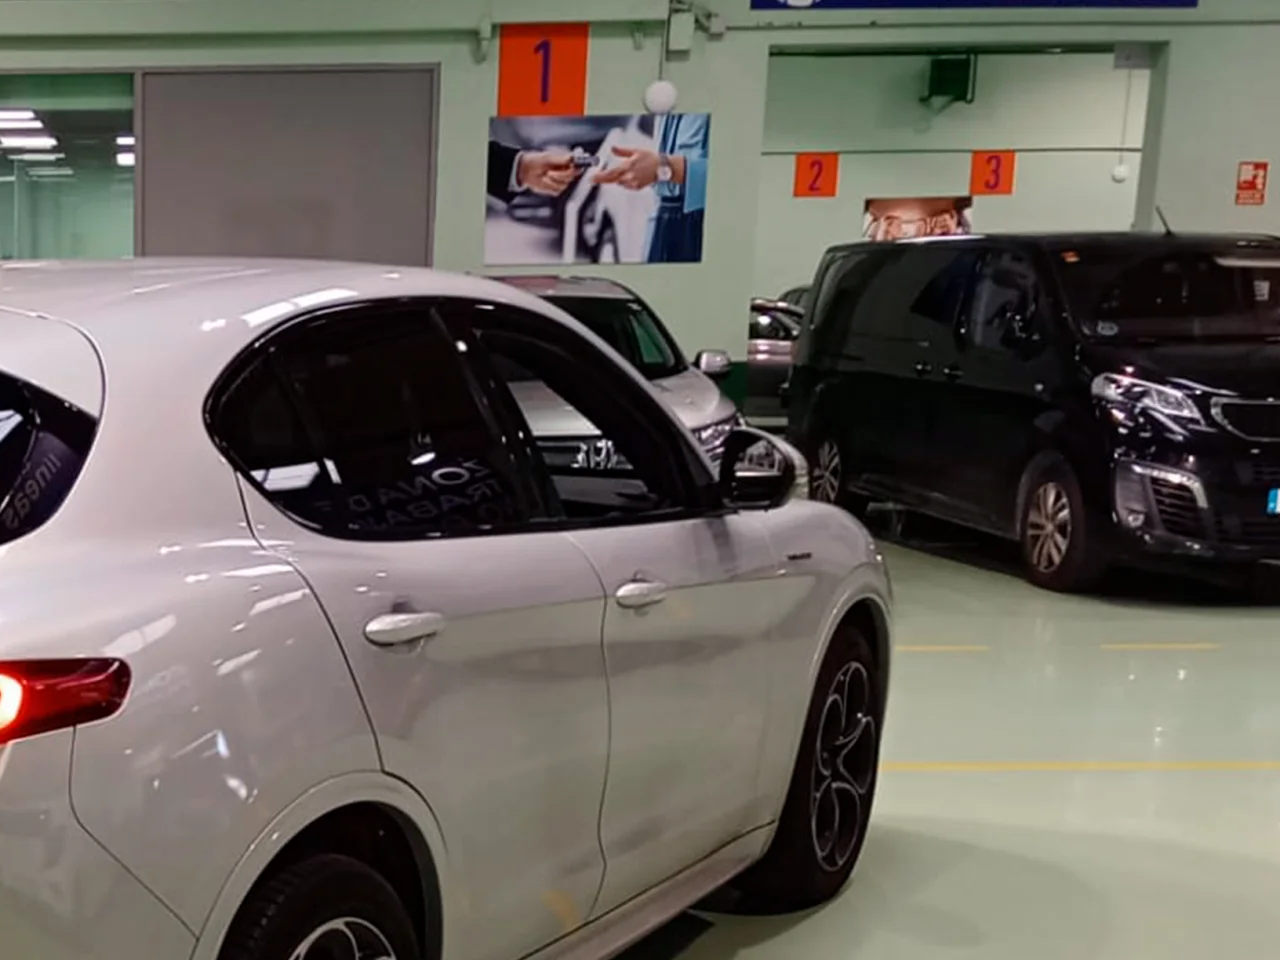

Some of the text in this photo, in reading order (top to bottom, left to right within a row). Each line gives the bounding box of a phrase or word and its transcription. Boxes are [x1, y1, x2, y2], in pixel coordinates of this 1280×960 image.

[533, 39, 551, 103] 1
[808, 159, 824, 192] 2
[984, 155, 1002, 190] 3
